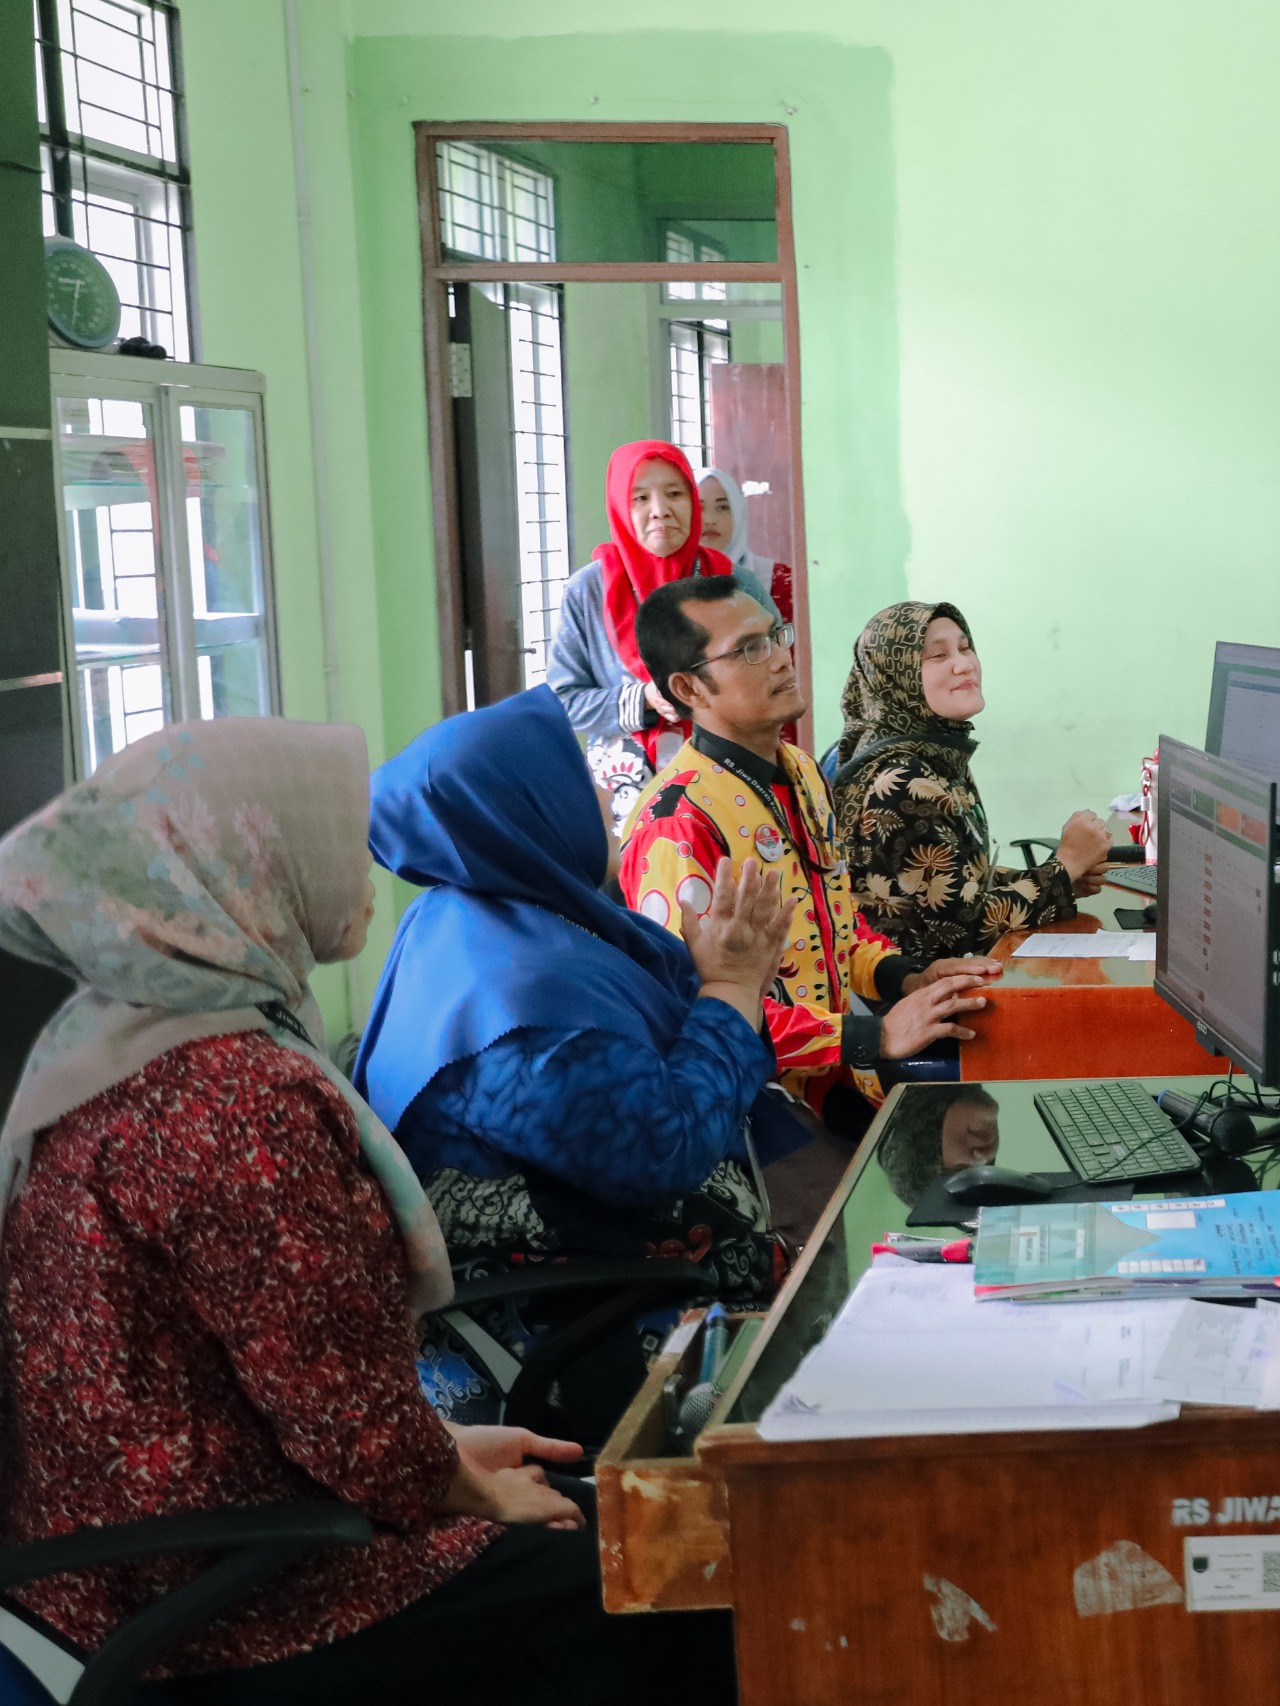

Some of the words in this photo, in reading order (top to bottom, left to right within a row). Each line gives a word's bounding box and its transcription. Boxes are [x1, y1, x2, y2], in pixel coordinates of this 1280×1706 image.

[736, 768, 752, 782] Jiwa
[751, 779, 771, 802] Daerah
[1172, 1497, 1211, 1527] RS
